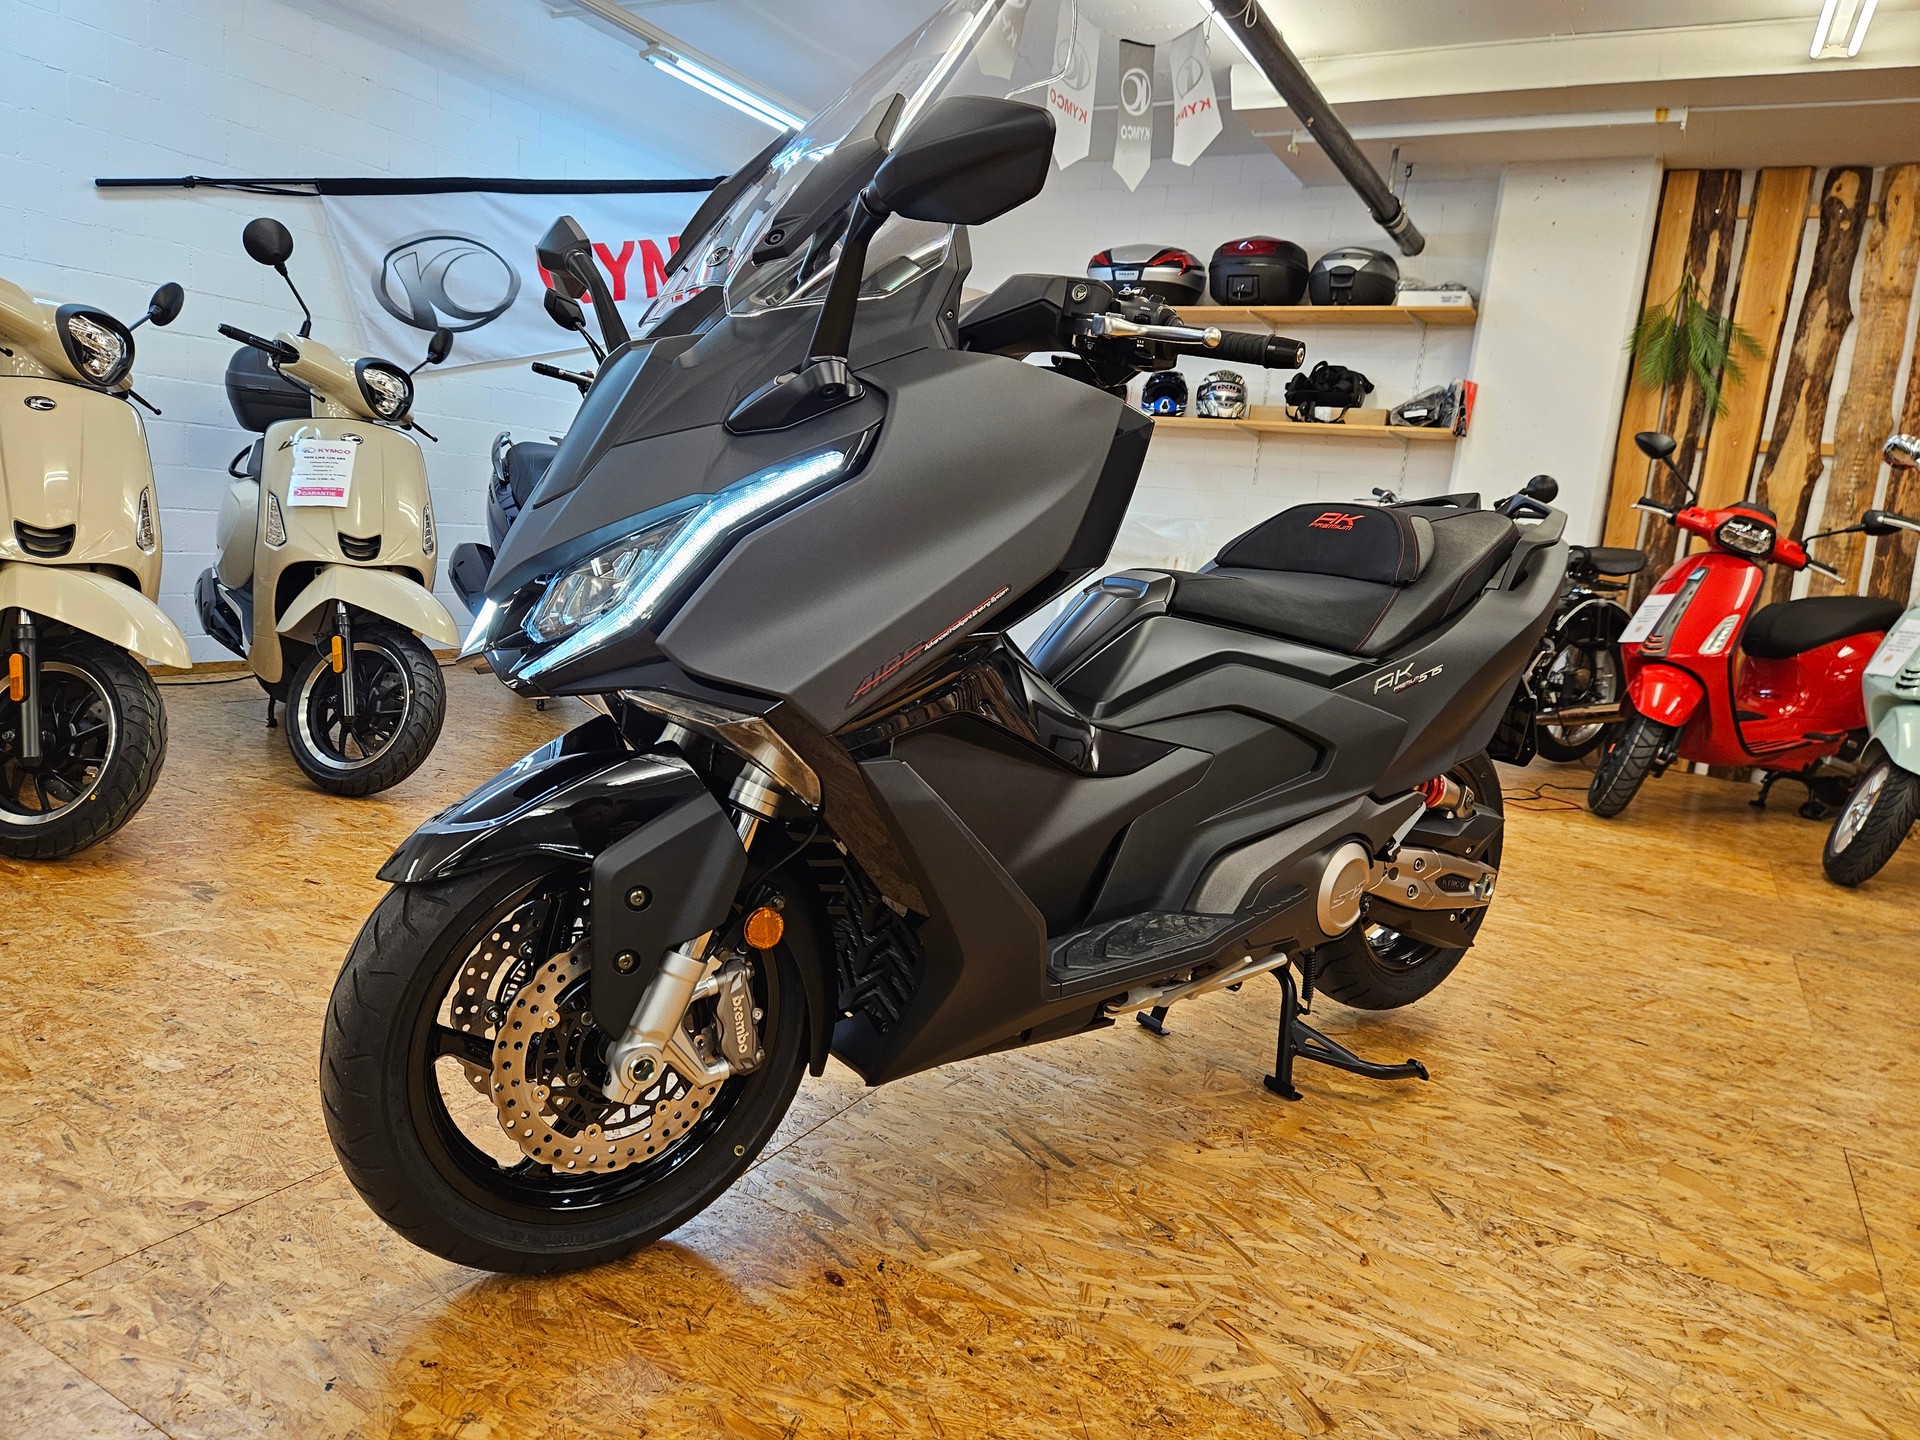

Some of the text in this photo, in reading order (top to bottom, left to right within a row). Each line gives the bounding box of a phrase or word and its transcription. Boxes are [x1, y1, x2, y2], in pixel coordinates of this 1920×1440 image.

[1309, 522, 1353, 531] PREMIUM
[1441, 878, 1465, 889] KYMCO
[732, 994, 750, 1054] brembo
